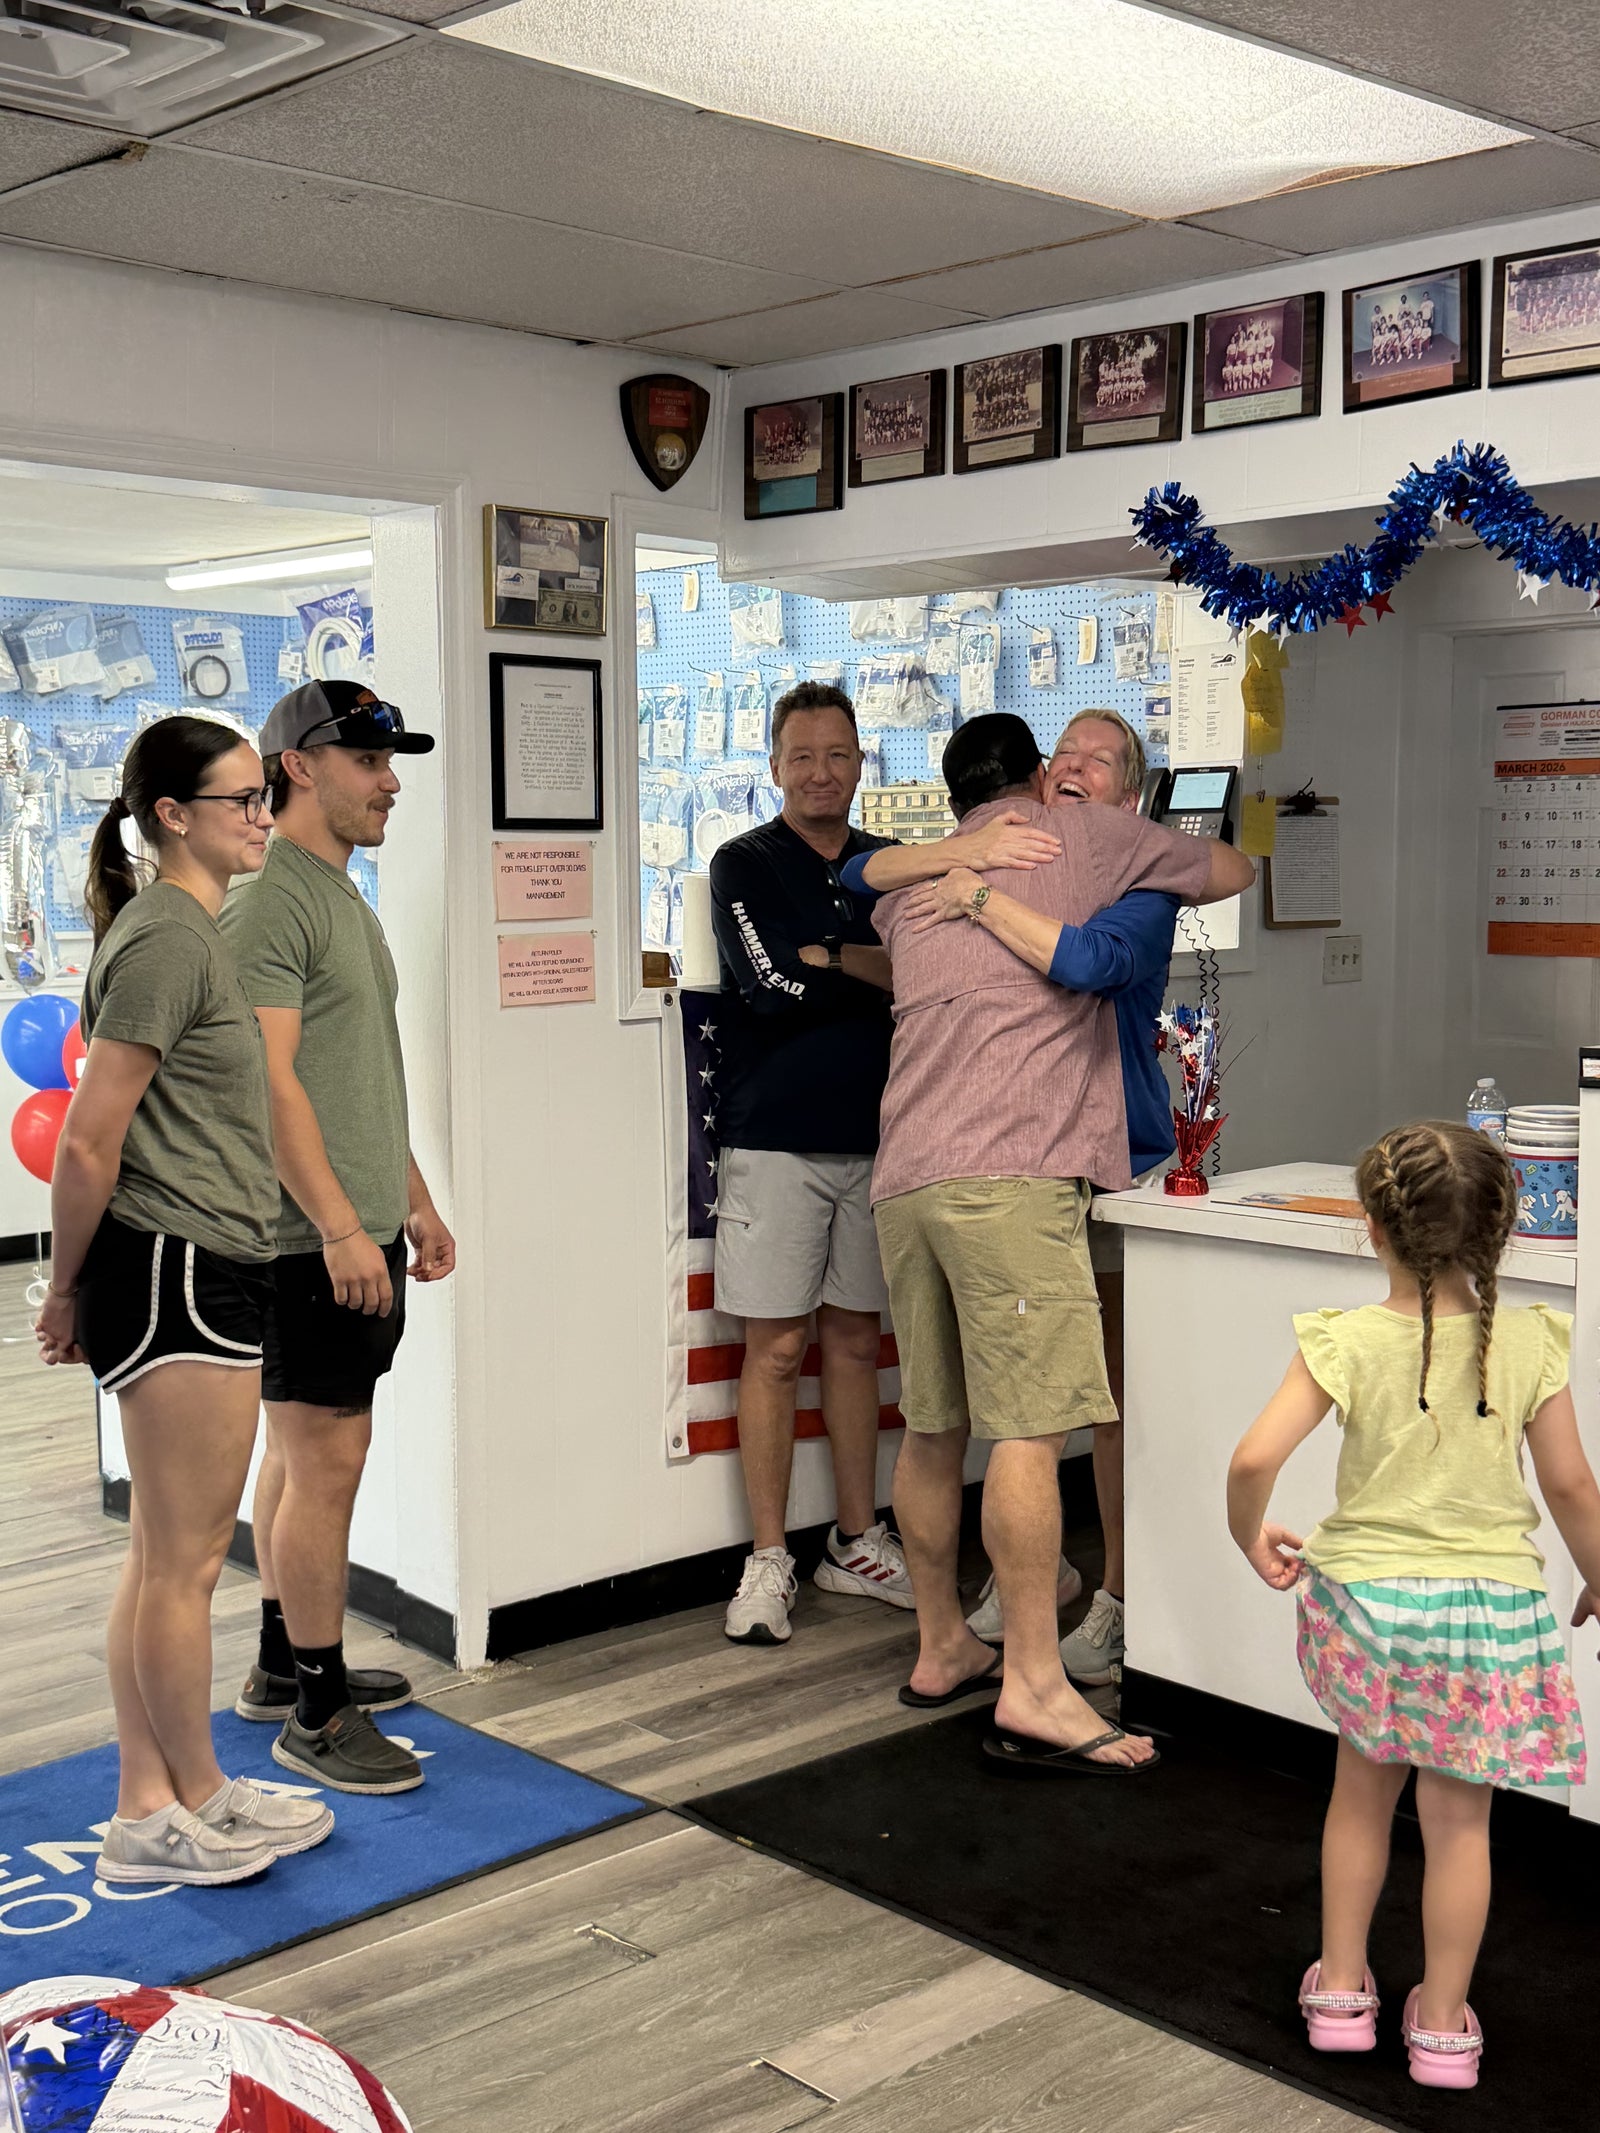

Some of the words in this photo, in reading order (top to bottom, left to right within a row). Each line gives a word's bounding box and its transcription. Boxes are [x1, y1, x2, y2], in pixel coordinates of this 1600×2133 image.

[1541, 711, 1586, 721] GORMAN
[1497, 763, 1537, 774] MARCH
[1540, 762, 1566, 773] 2026
[1504, 784, 1508, 793] 1
[1526, 784, 1532, 793] 2
[1550, 783, 1556, 792] 3
[1575, 782, 1581, 791] 4
[1501, 812, 1507, 821] 8
[1525, 812, 1530, 821] 9
[1547, 811, 1557, 820] 10
[1572, 811, 1582, 820] 11
[1498, 840, 1507, 849] 15
[1521, 840, 1531, 849] 16
[1546, 840, 1556, 849] 17
[1571, 840, 1582, 849] 18
[505, 852, 515, 860] WE
[516, 852, 528, 860] ARE
[1496, 868, 1506, 877] 22
[1520, 868, 1530, 877] 23
[1544, 868, 1555, 877] 24
[1569, 868, 1580, 877] 25
[551, 878, 562, 886] YOU
[526, 891, 565, 899] MANAGEMENT
[1495, 896, 1506, 905] 29
[1519, 896, 1529, 905] 30
[1543, 896, 1554, 906] 31
[731, 902, 805, 997] HAMMEREAD
